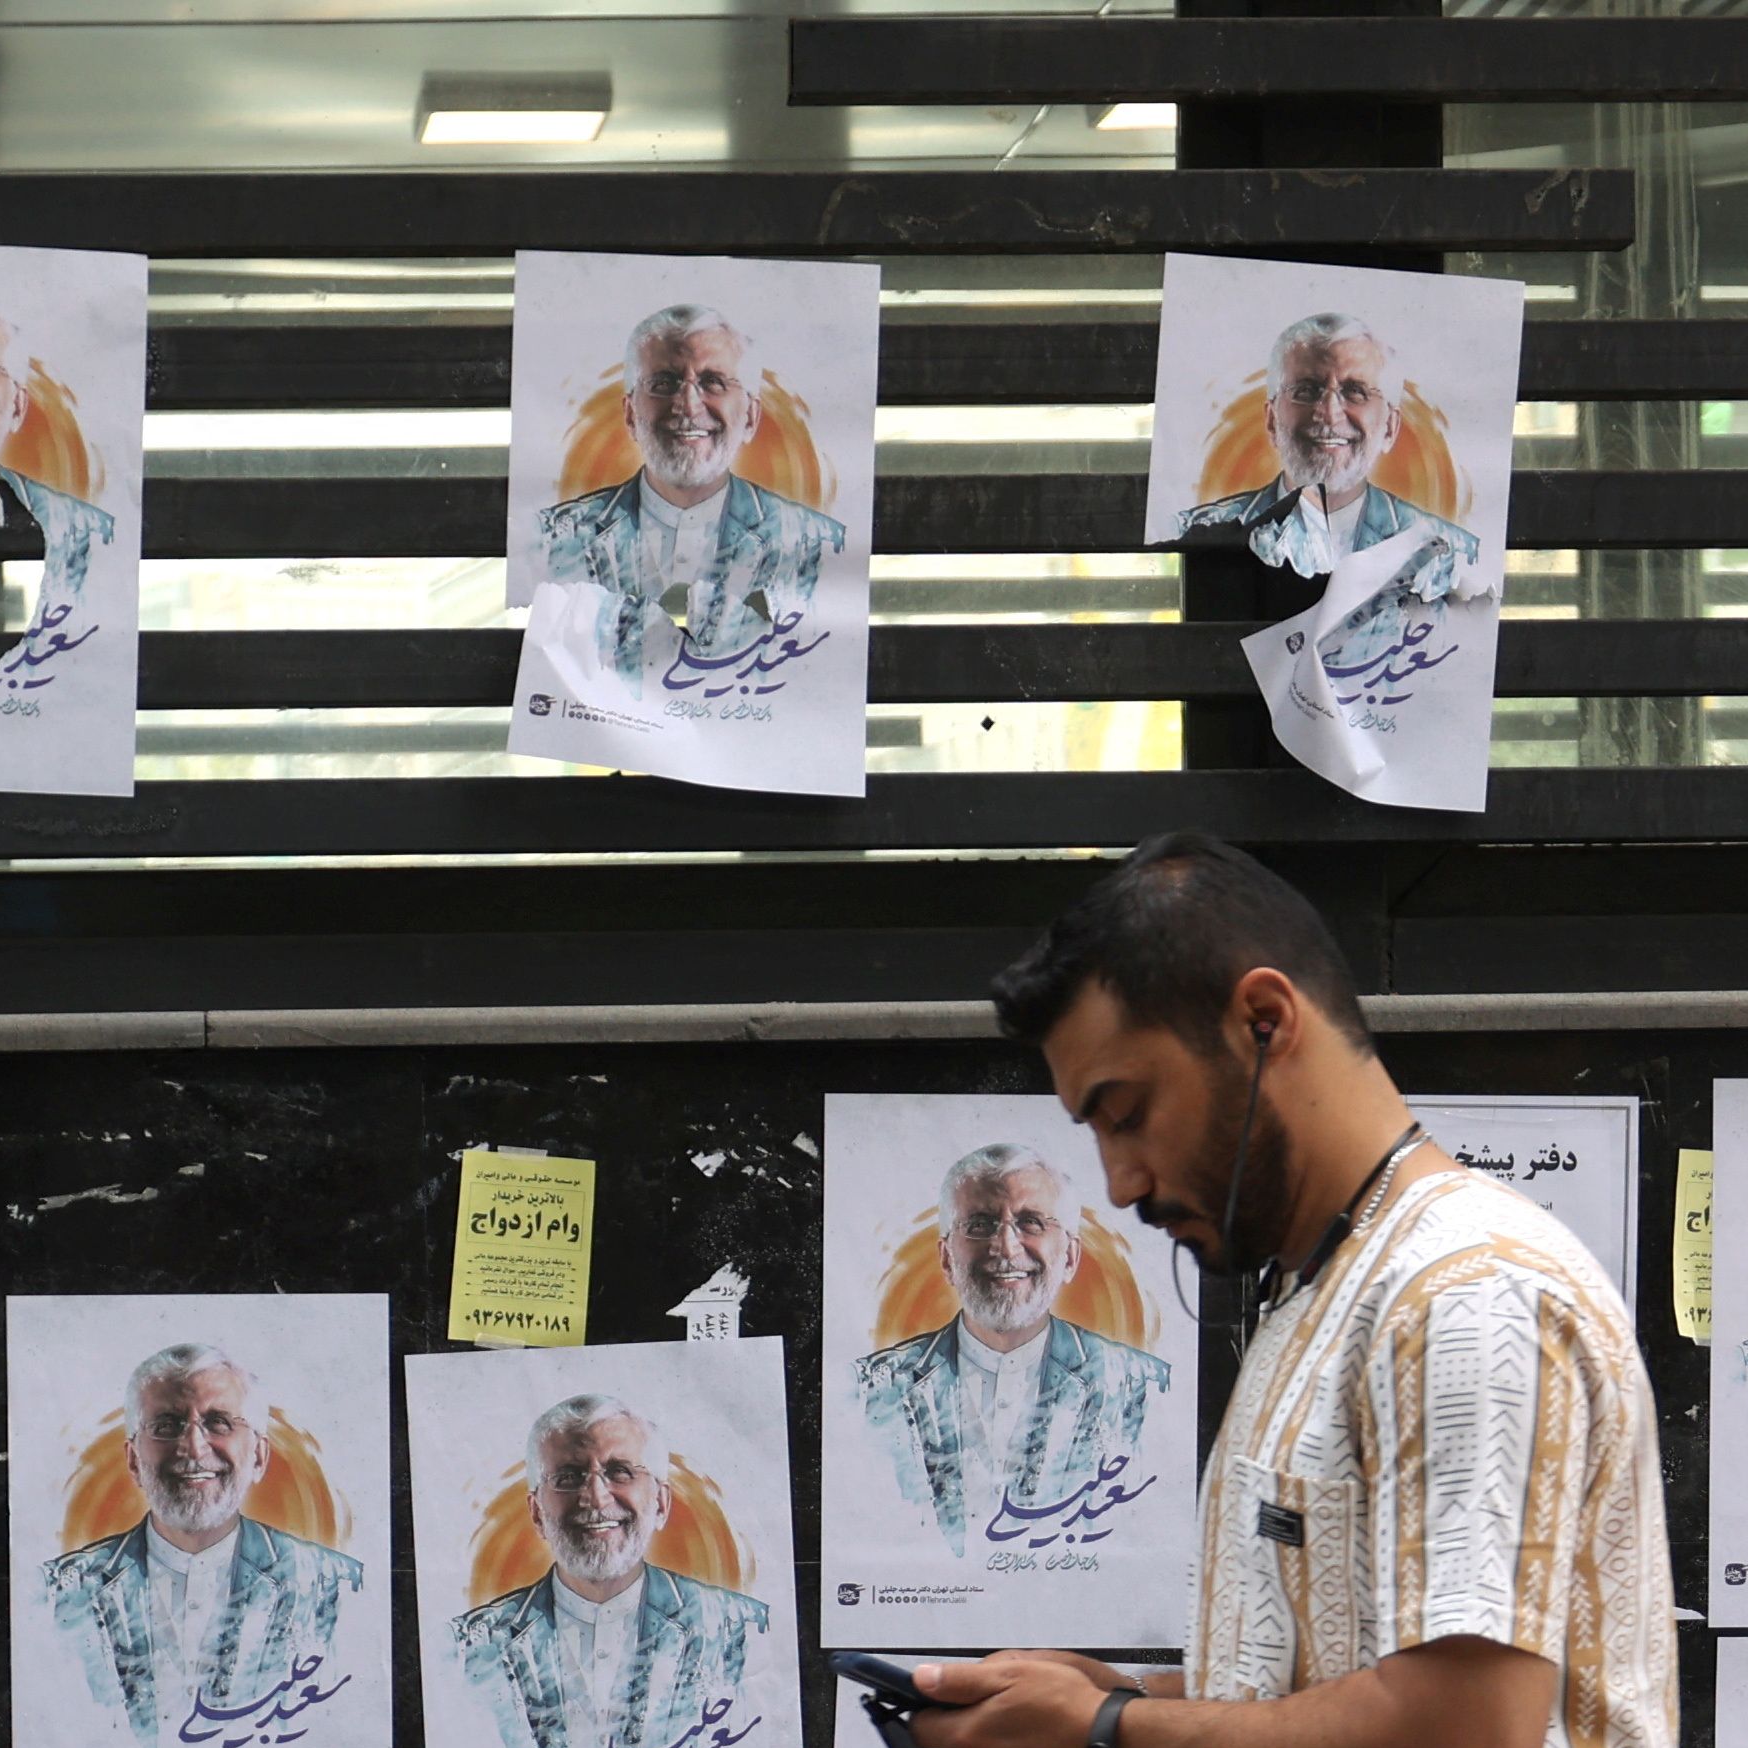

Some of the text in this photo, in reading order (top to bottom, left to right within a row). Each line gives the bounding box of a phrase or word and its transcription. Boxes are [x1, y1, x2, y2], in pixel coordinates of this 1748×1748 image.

[3, 625, 100, 690] سعید
[662, 609, 830, 699] سعید جلیلی
[1363, 644, 1460, 706] سعید
[1522, 1142, 1578, 1181] دفتر
[471, 1207, 580, 1242] وام ازدواج
[492, 1190, 564, 1209] بالاترین خریدار
[984, 1452, 1158, 1549] سعید جلیلی
[255, 1674, 352, 1744] سعید
